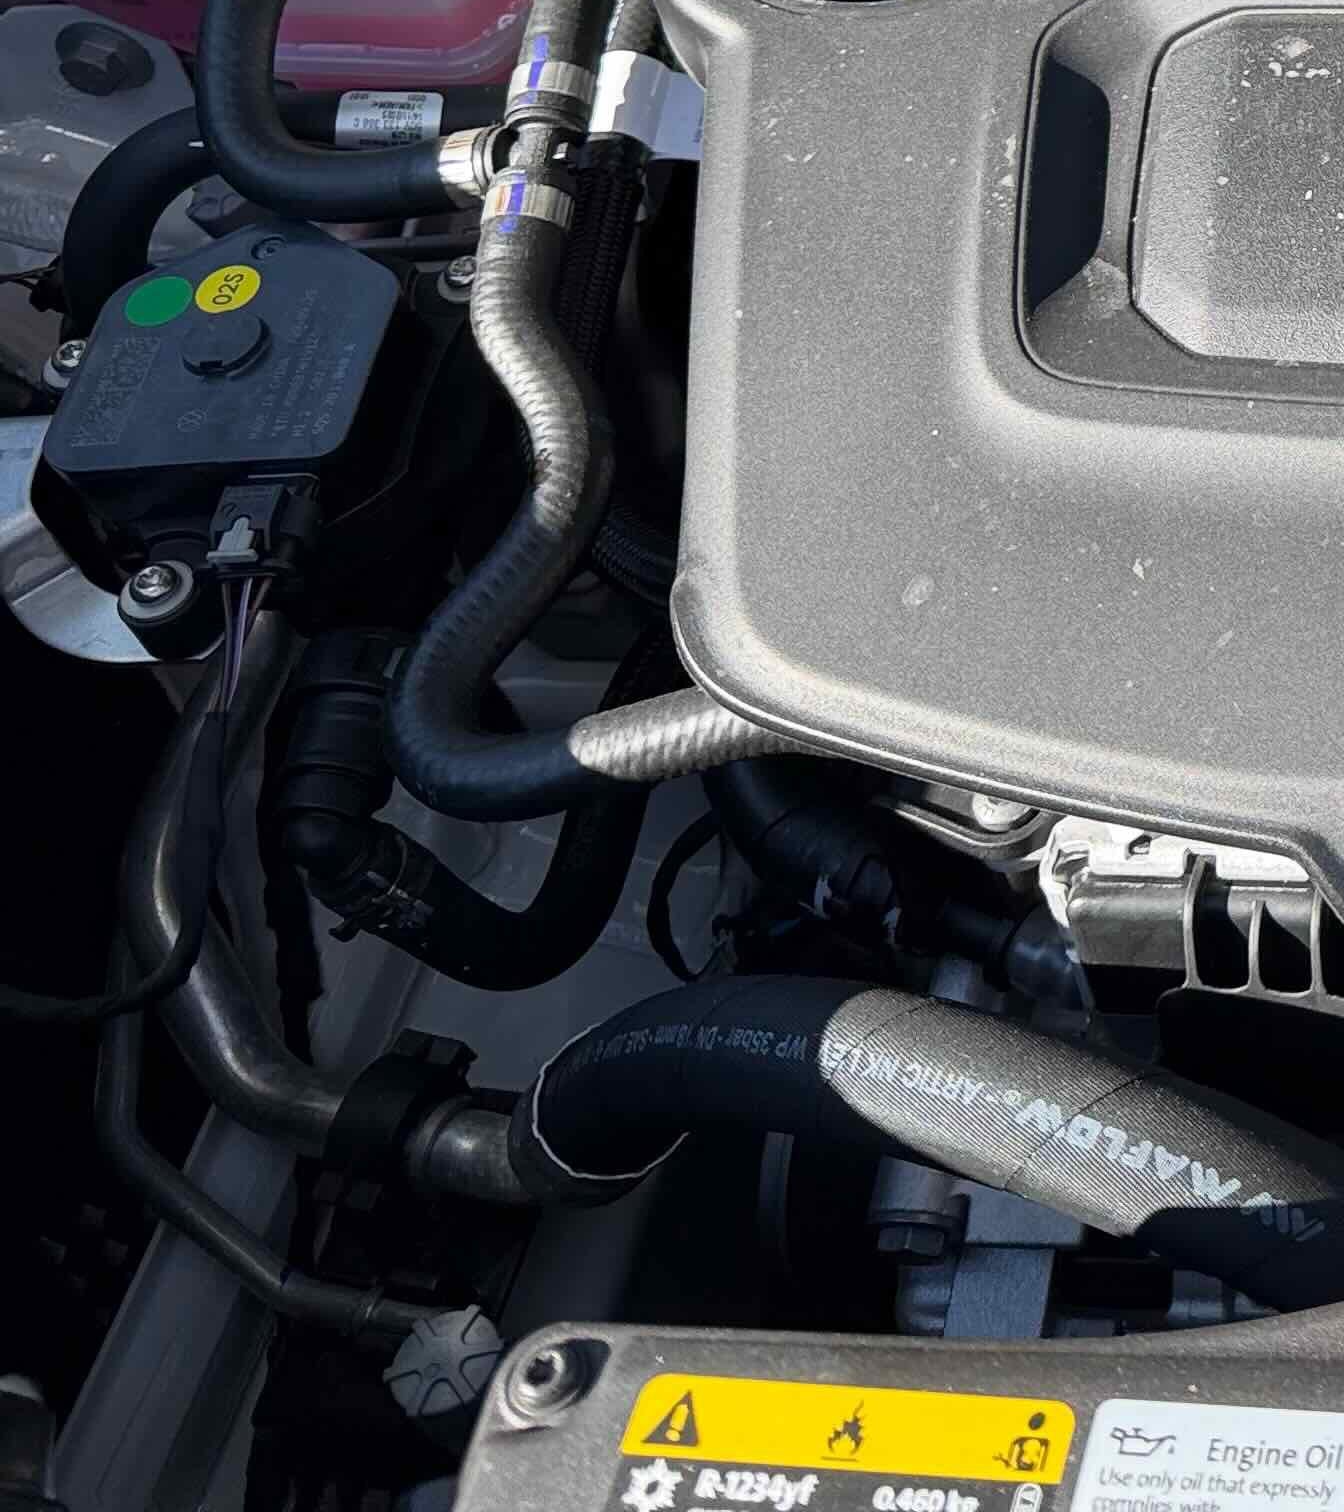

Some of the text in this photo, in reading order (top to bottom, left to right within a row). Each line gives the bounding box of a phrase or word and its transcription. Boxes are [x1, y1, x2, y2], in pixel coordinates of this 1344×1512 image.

[212, 272, 245, 306] 02S
[1013, 1097, 1241, 1204] MAFLOW
[1206, 1438, 1344, 1472] Engine Oil
[1098, 1466, 1337, 1505] Use only oil that expressly
